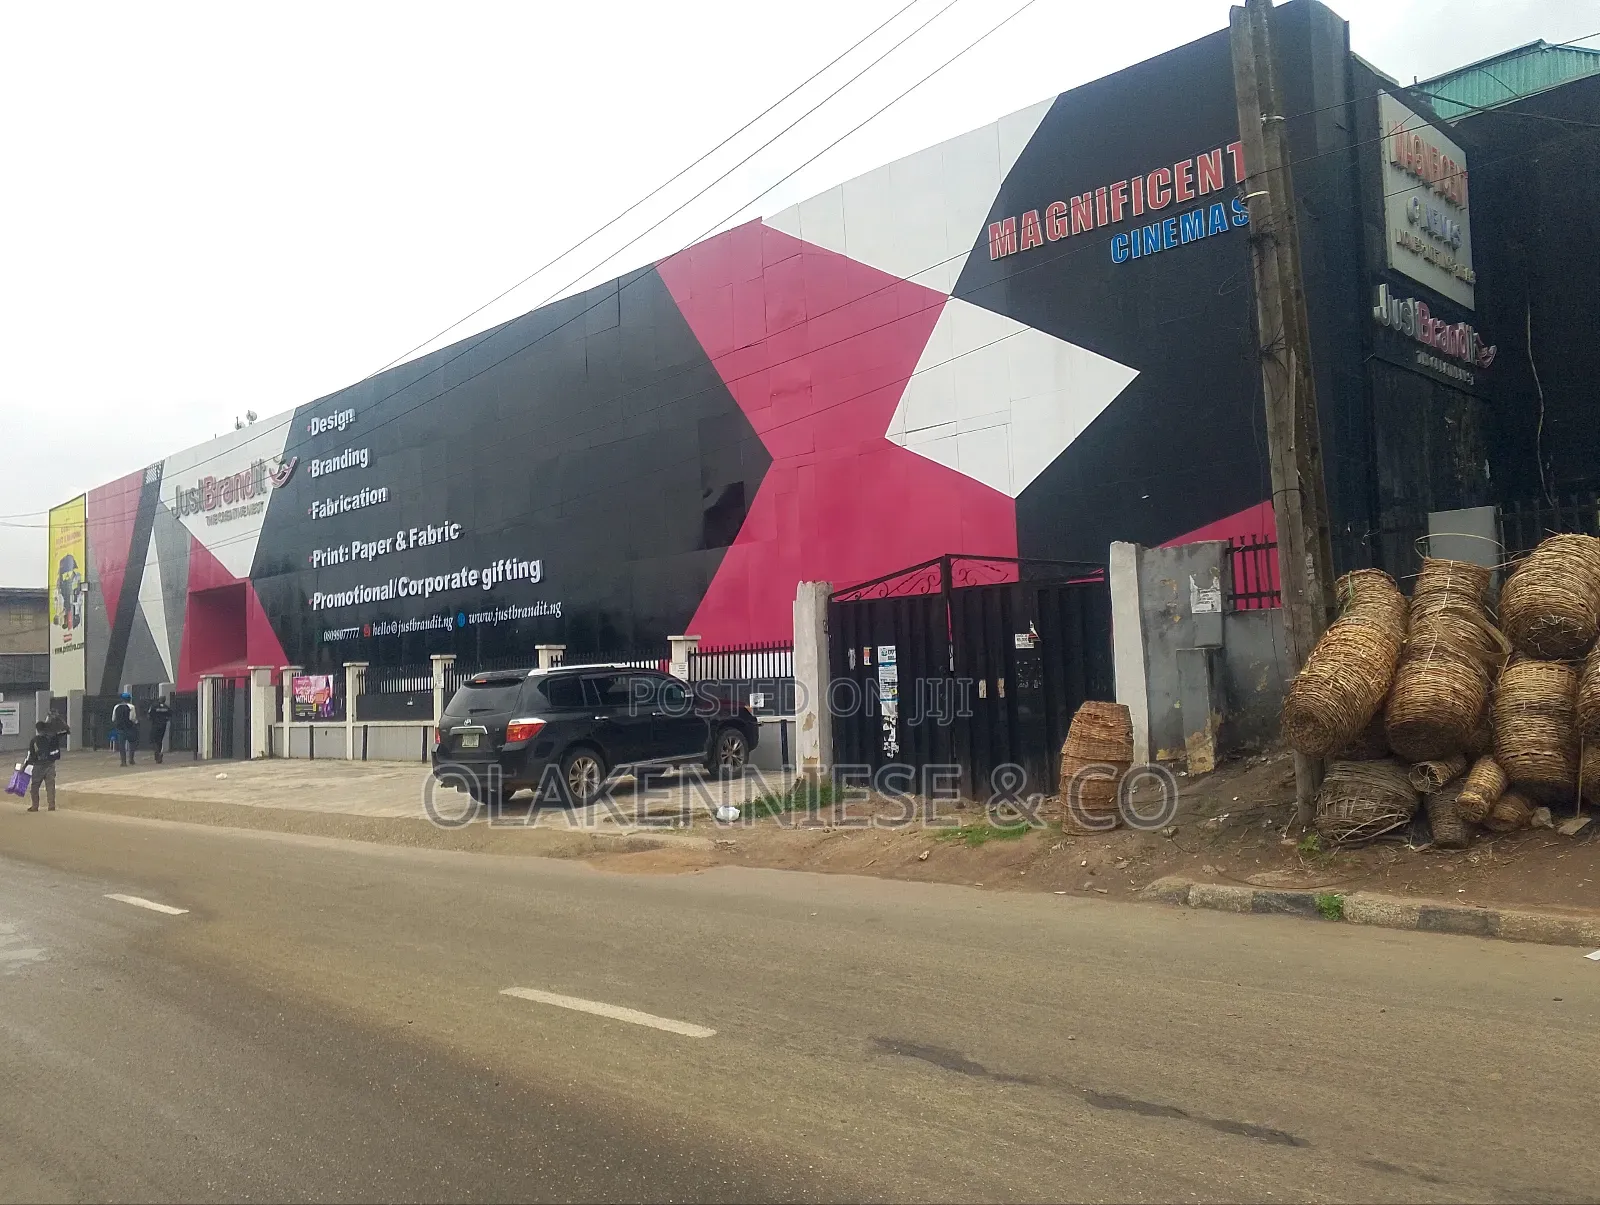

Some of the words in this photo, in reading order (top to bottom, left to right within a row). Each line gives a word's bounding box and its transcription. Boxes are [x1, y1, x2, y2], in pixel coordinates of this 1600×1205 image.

[988, 140, 1246, 261] MAGNIFICENT
[1110, 198, 1250, 264] CINEMAS
[310, 408, 356, 436] Design
[311, 447, 369, 478] Branding
[312, 486, 388, 520] Fabrication
[312, 546, 349, 569] Print:
[351, 537, 393, 562] Paper
[395, 531, 407, 552] &
[409, 520, 462, 549] Fabric
[312, 566, 479, 611] Promotional/Corporate
[482, 557, 542, 591] gifting
[372, 614, 454, 638] hello@justbrandit.ng
[468, 600, 562, 627] www.justbrandit.ng
